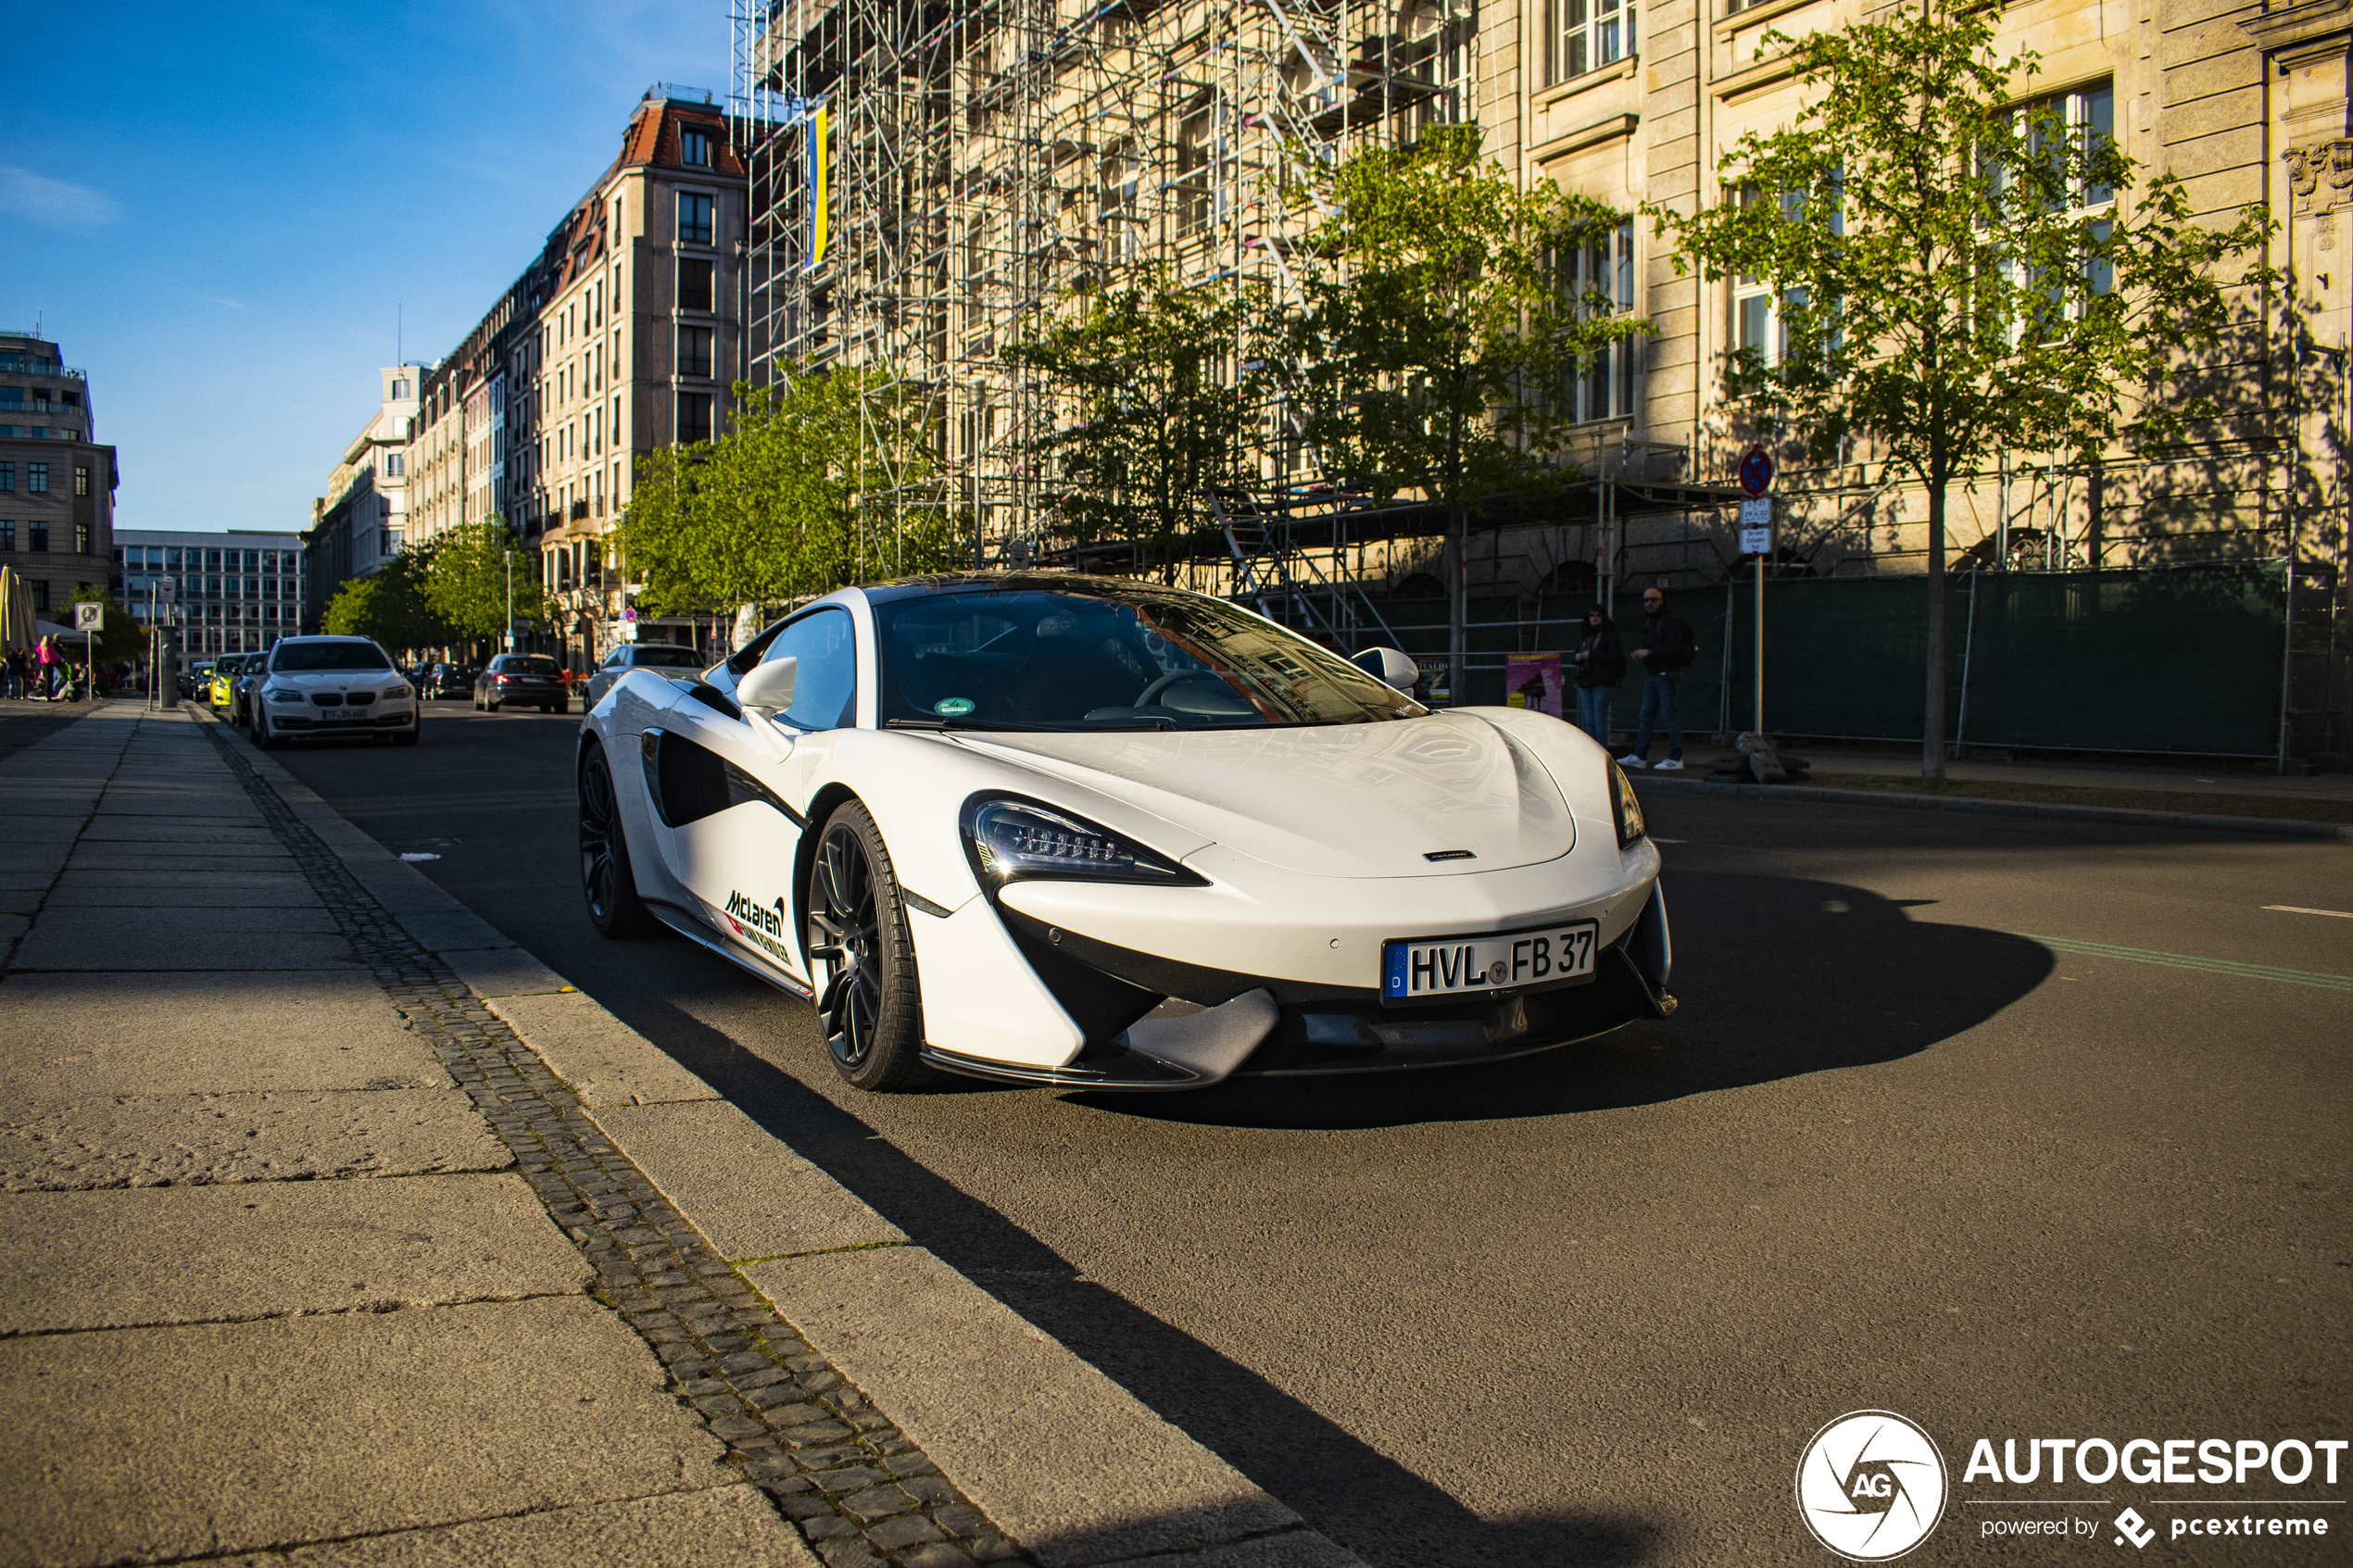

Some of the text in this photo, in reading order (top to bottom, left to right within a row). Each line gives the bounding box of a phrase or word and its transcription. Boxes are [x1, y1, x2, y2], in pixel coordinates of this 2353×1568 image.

[1431, 851, 1467, 859] McLaren
[725, 889, 784, 938] McLaren
[1392, 930, 1593, 991] D HVL FB 37
